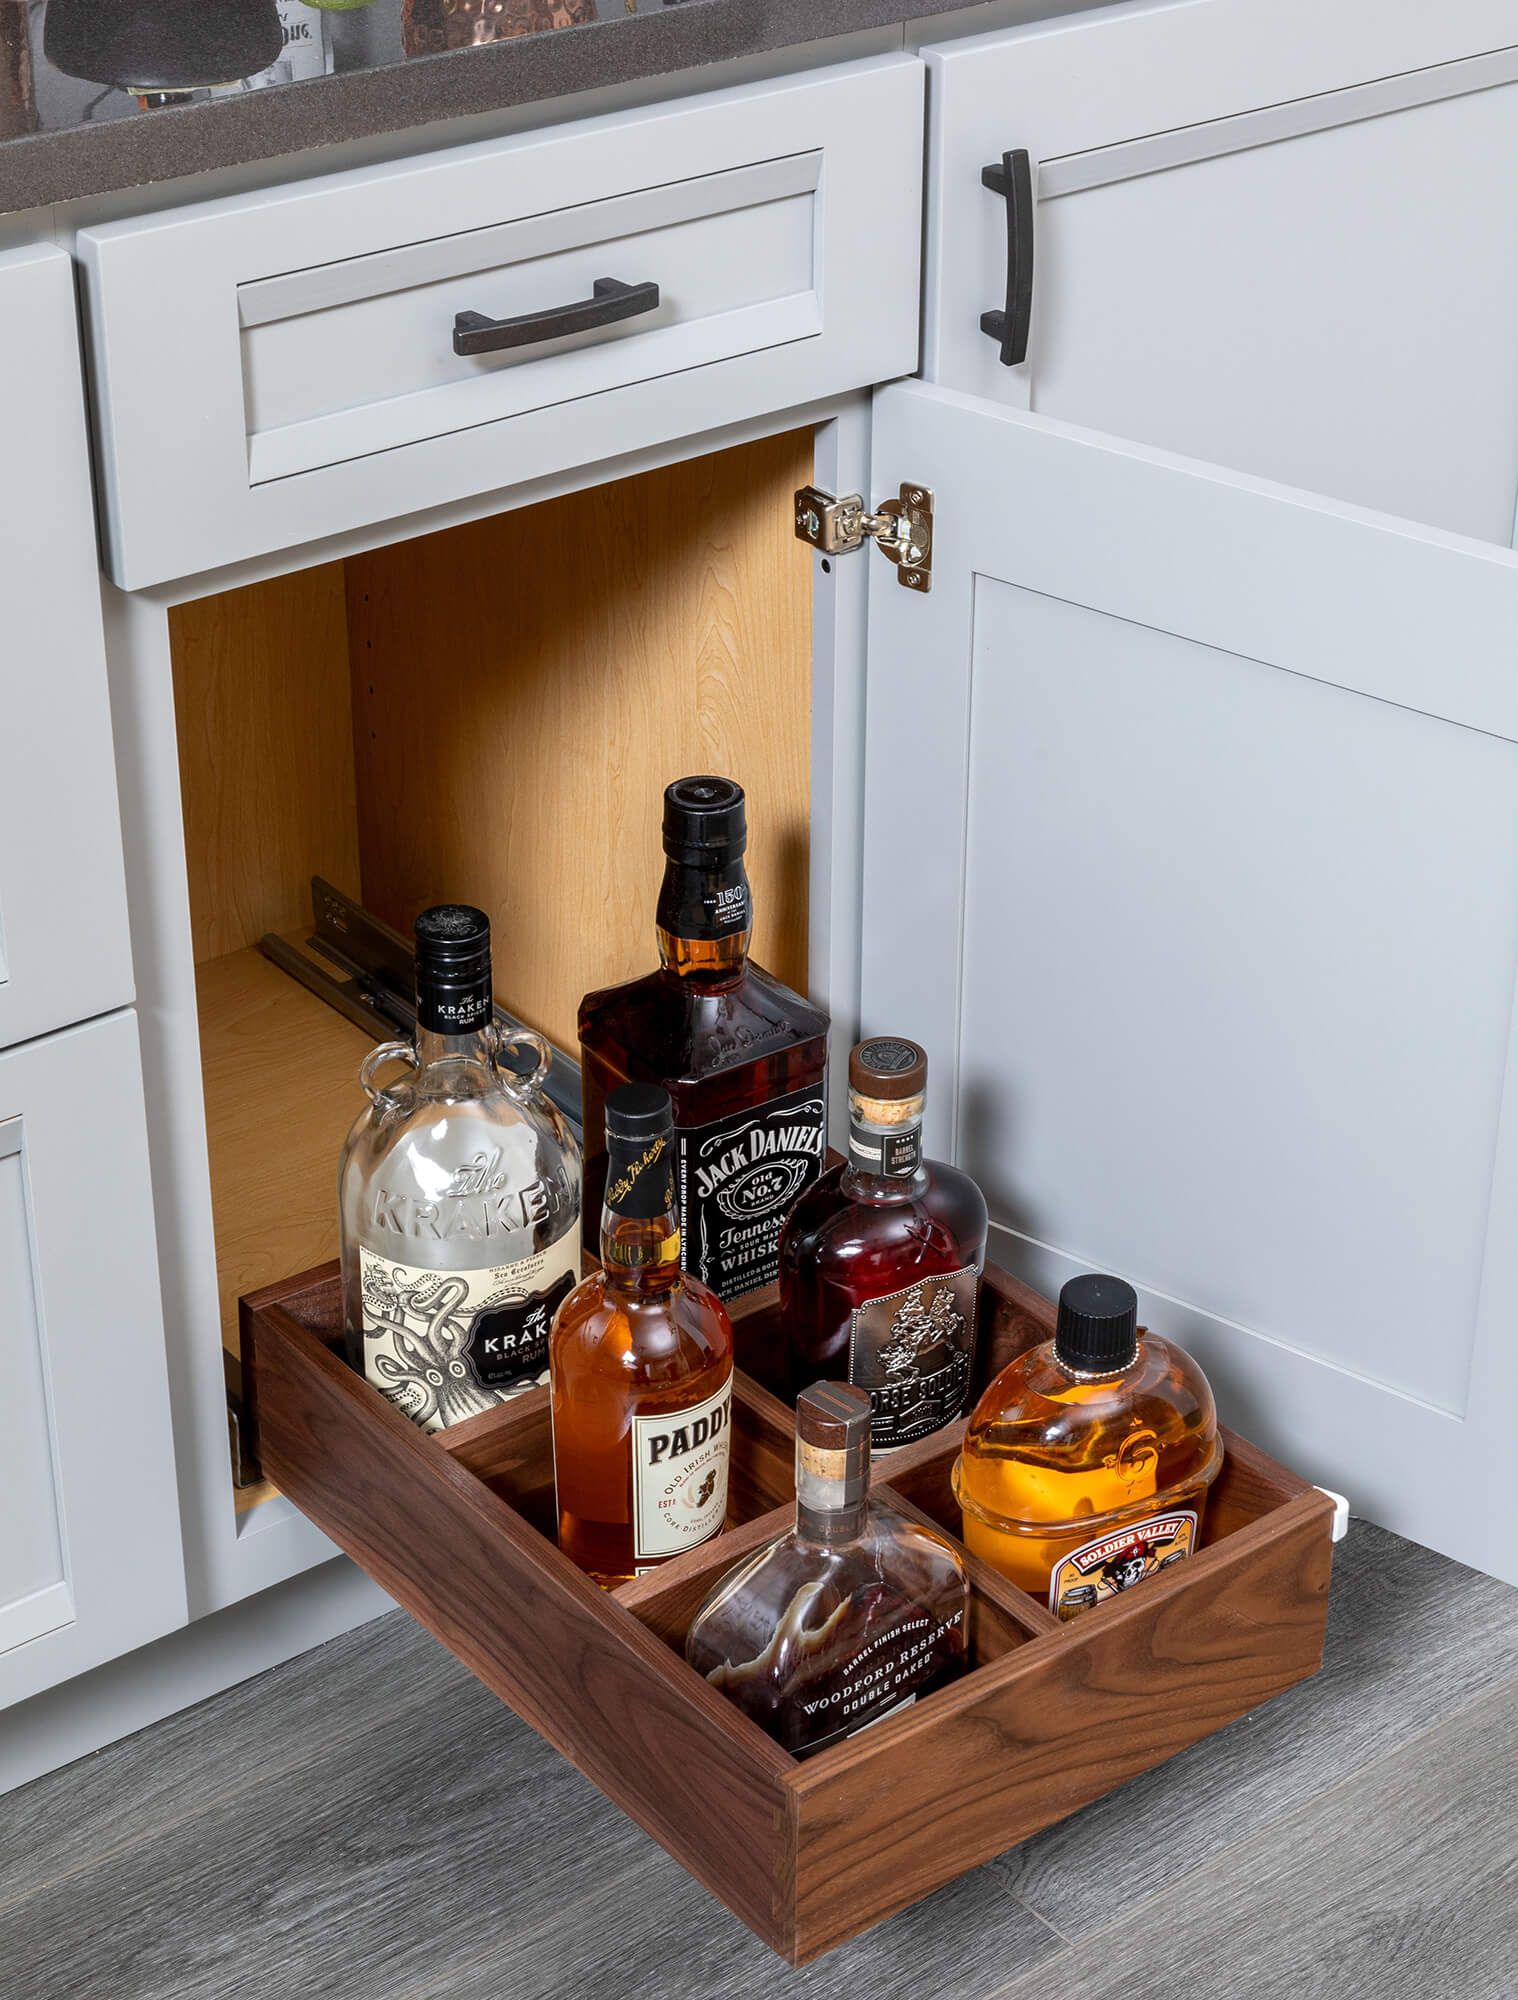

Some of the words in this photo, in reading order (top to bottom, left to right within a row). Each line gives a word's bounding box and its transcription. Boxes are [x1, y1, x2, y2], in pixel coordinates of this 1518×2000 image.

[437, 995, 489, 1014] KRAKEN
[459, 1017, 475, 1025] RUM
[680, 1159, 688, 1183] EVERY
[694, 1143, 739, 1198] JACK
[751, 1171, 773, 1186] Old
[680, 1184, 688, 1205] DROP
[751, 1194, 775, 1207] BRAND
[680, 1206, 688, 1227] MADE
[739, 1238, 761, 1250] SOUR
[721, 1268, 756, 1288] DISTILLED
[522, 1304, 546, 1329] The
[496, 1345, 531, 1361] BLACK
[648, 1396, 732, 1466] PADDY
[664, 1475, 682, 1495] OLD
[683, 1449, 711, 1474] IRISH
[1079, 1537, 1135, 1567] SOLDIER
[1136, 1522, 1180, 1541] VALLEY
[842, 1646, 873, 1676] BARREL
[873, 1627, 901, 1649] FINISH
[902, 1618, 929, 1633] SELECT
[803, 1661, 895, 1715] WOODFORD
[899, 1611, 963, 1665] RESERVE
[843, 1680, 890, 1715] DOUBLE
[895, 1651, 933, 1684] OAKED
